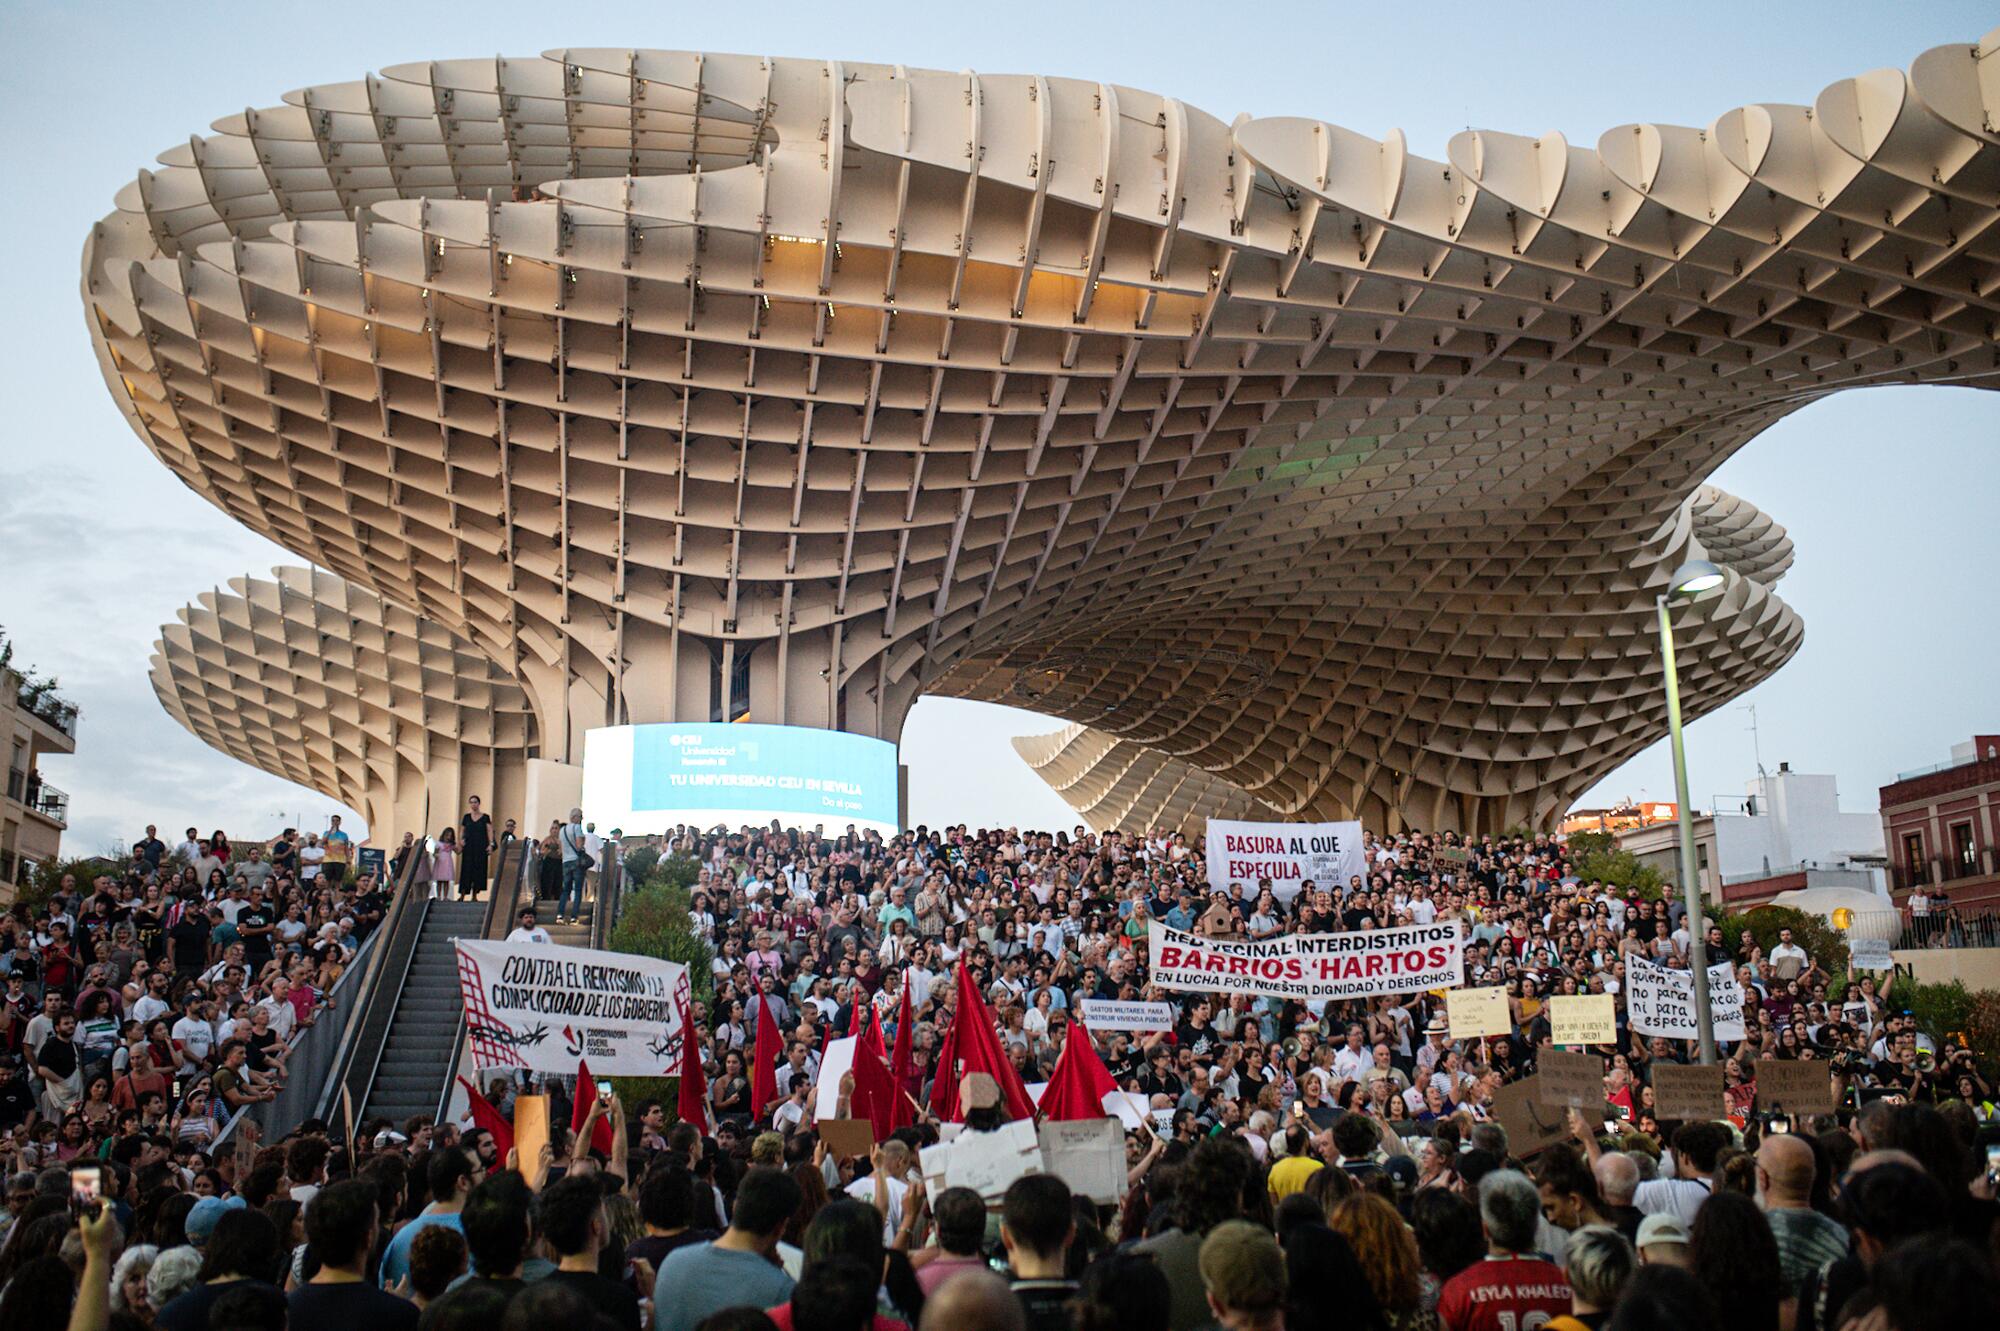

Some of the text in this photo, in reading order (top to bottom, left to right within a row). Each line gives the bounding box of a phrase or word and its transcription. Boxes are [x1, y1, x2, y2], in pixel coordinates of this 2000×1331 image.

[670, 774, 688, 787] TU
[690, 774, 777, 789] UNIVERSIDAD
[778, 776, 803, 789] CEU
[822, 780, 863, 796] SEVILLA
[1226, 834, 1341, 855] BASURA AL QUE
[1229, 860, 1302, 881] ESPECULA
[1297, 925, 1455, 954] INTERDISTRITOS
[1160, 946, 1303, 980] BARRIOS
[501, 955, 666, 998] CONTRA EL RENTISMO Y LA
[1155, 971, 1173, 983] EN
[1175, 972, 1220, 986] LUCHA
[1224, 976, 1251, 988] POR
[1312, 981, 1374, 996] DIGNIDAD
[1376, 980, 1385, 991] Y
[1388, 971, 1455, 990] DERECHOS
[1631, 970, 1666, 985] quien
[492, 983, 586, 1016] COMPLICIDAD
[583, 992, 603, 1018] DE
[601, 994, 623, 1019] LOS
[1632, 987, 1649, 999] no
[1657, 988, 1689, 1002] para
[1089, 1006, 1113, 1014] GASTOS
[1147, 1008, 1164, 1016] PARA
[1117, 1016, 1144, 1024] VIVIENDA
[1633, 1002, 1688, 1018] ni para
[1469, 1285, 1513, 1303] LEYLA
